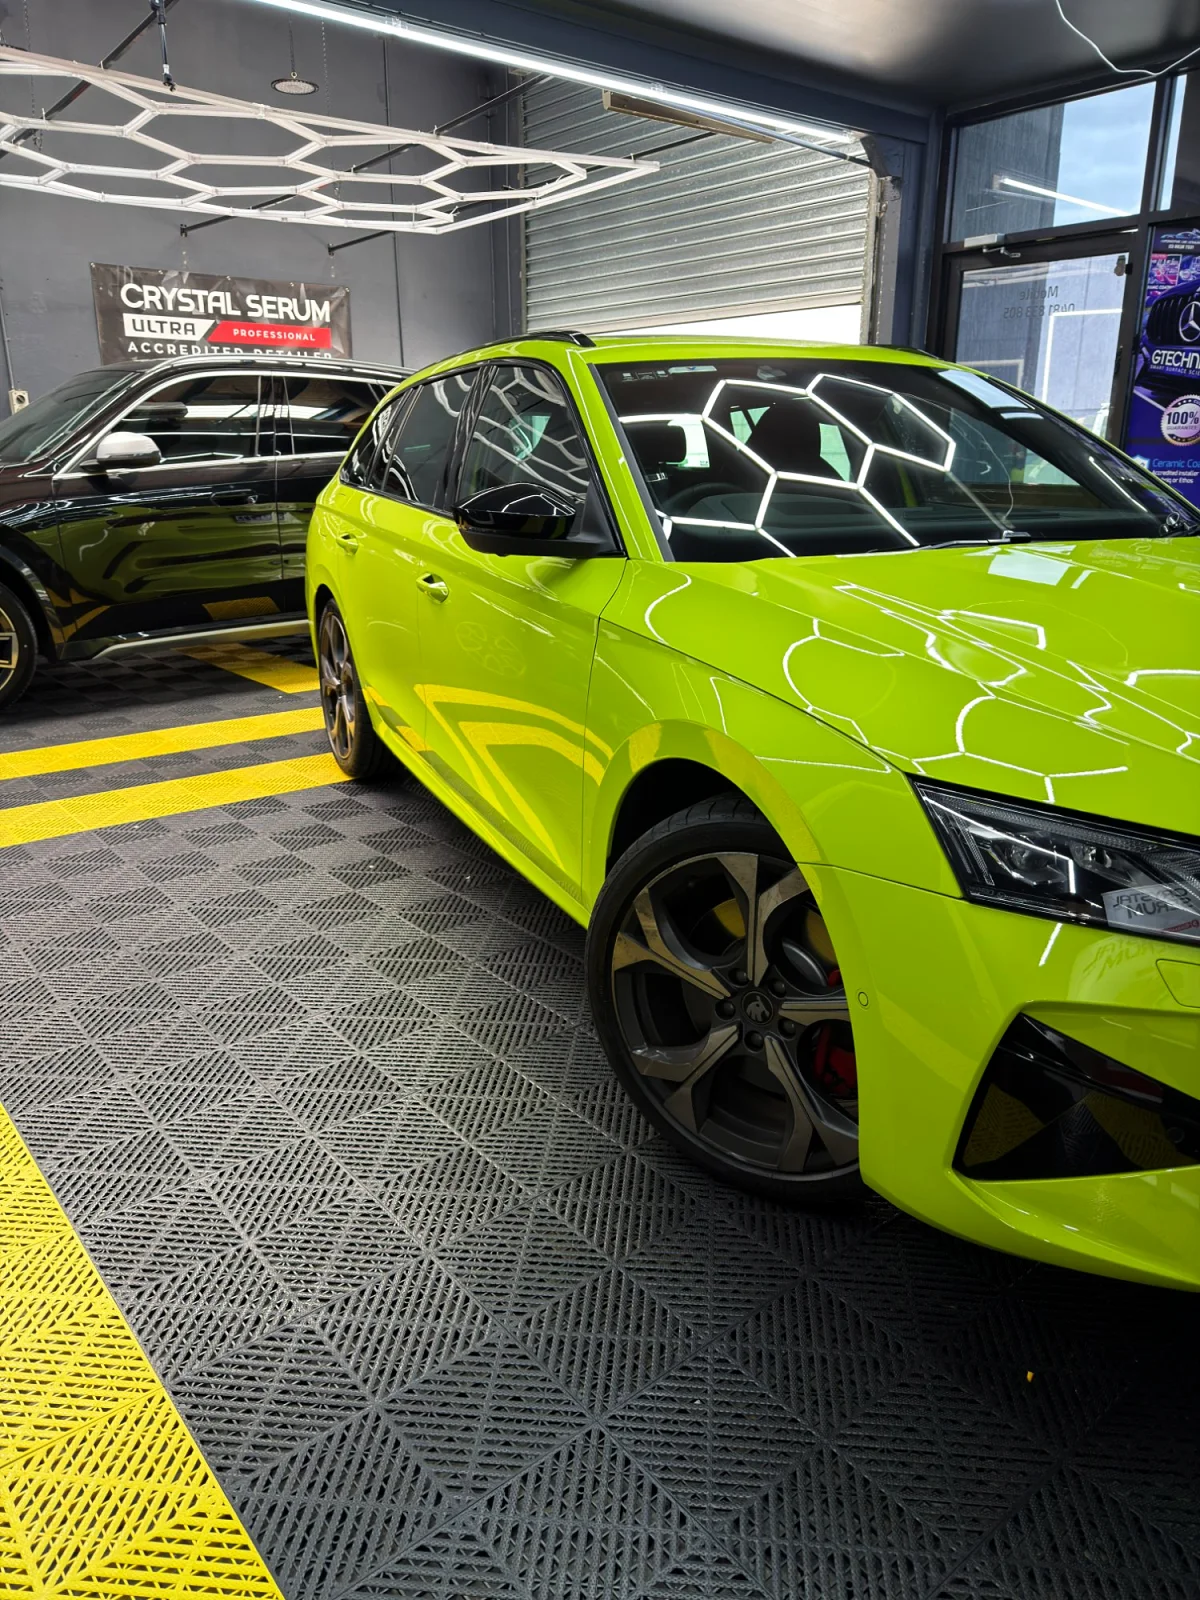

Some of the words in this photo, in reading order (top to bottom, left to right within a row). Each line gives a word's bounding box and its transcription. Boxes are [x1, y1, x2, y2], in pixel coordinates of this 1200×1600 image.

[120, 283, 241, 316] CRYSTAL
[245, 294, 330, 322] SERUM
[132, 319, 196, 336] ULTRA
[233, 328, 316, 341] PROFESSIONAL
[1166, 411, 1199, 425] 100%
[1152, 459, 1185, 468] Ceramic
